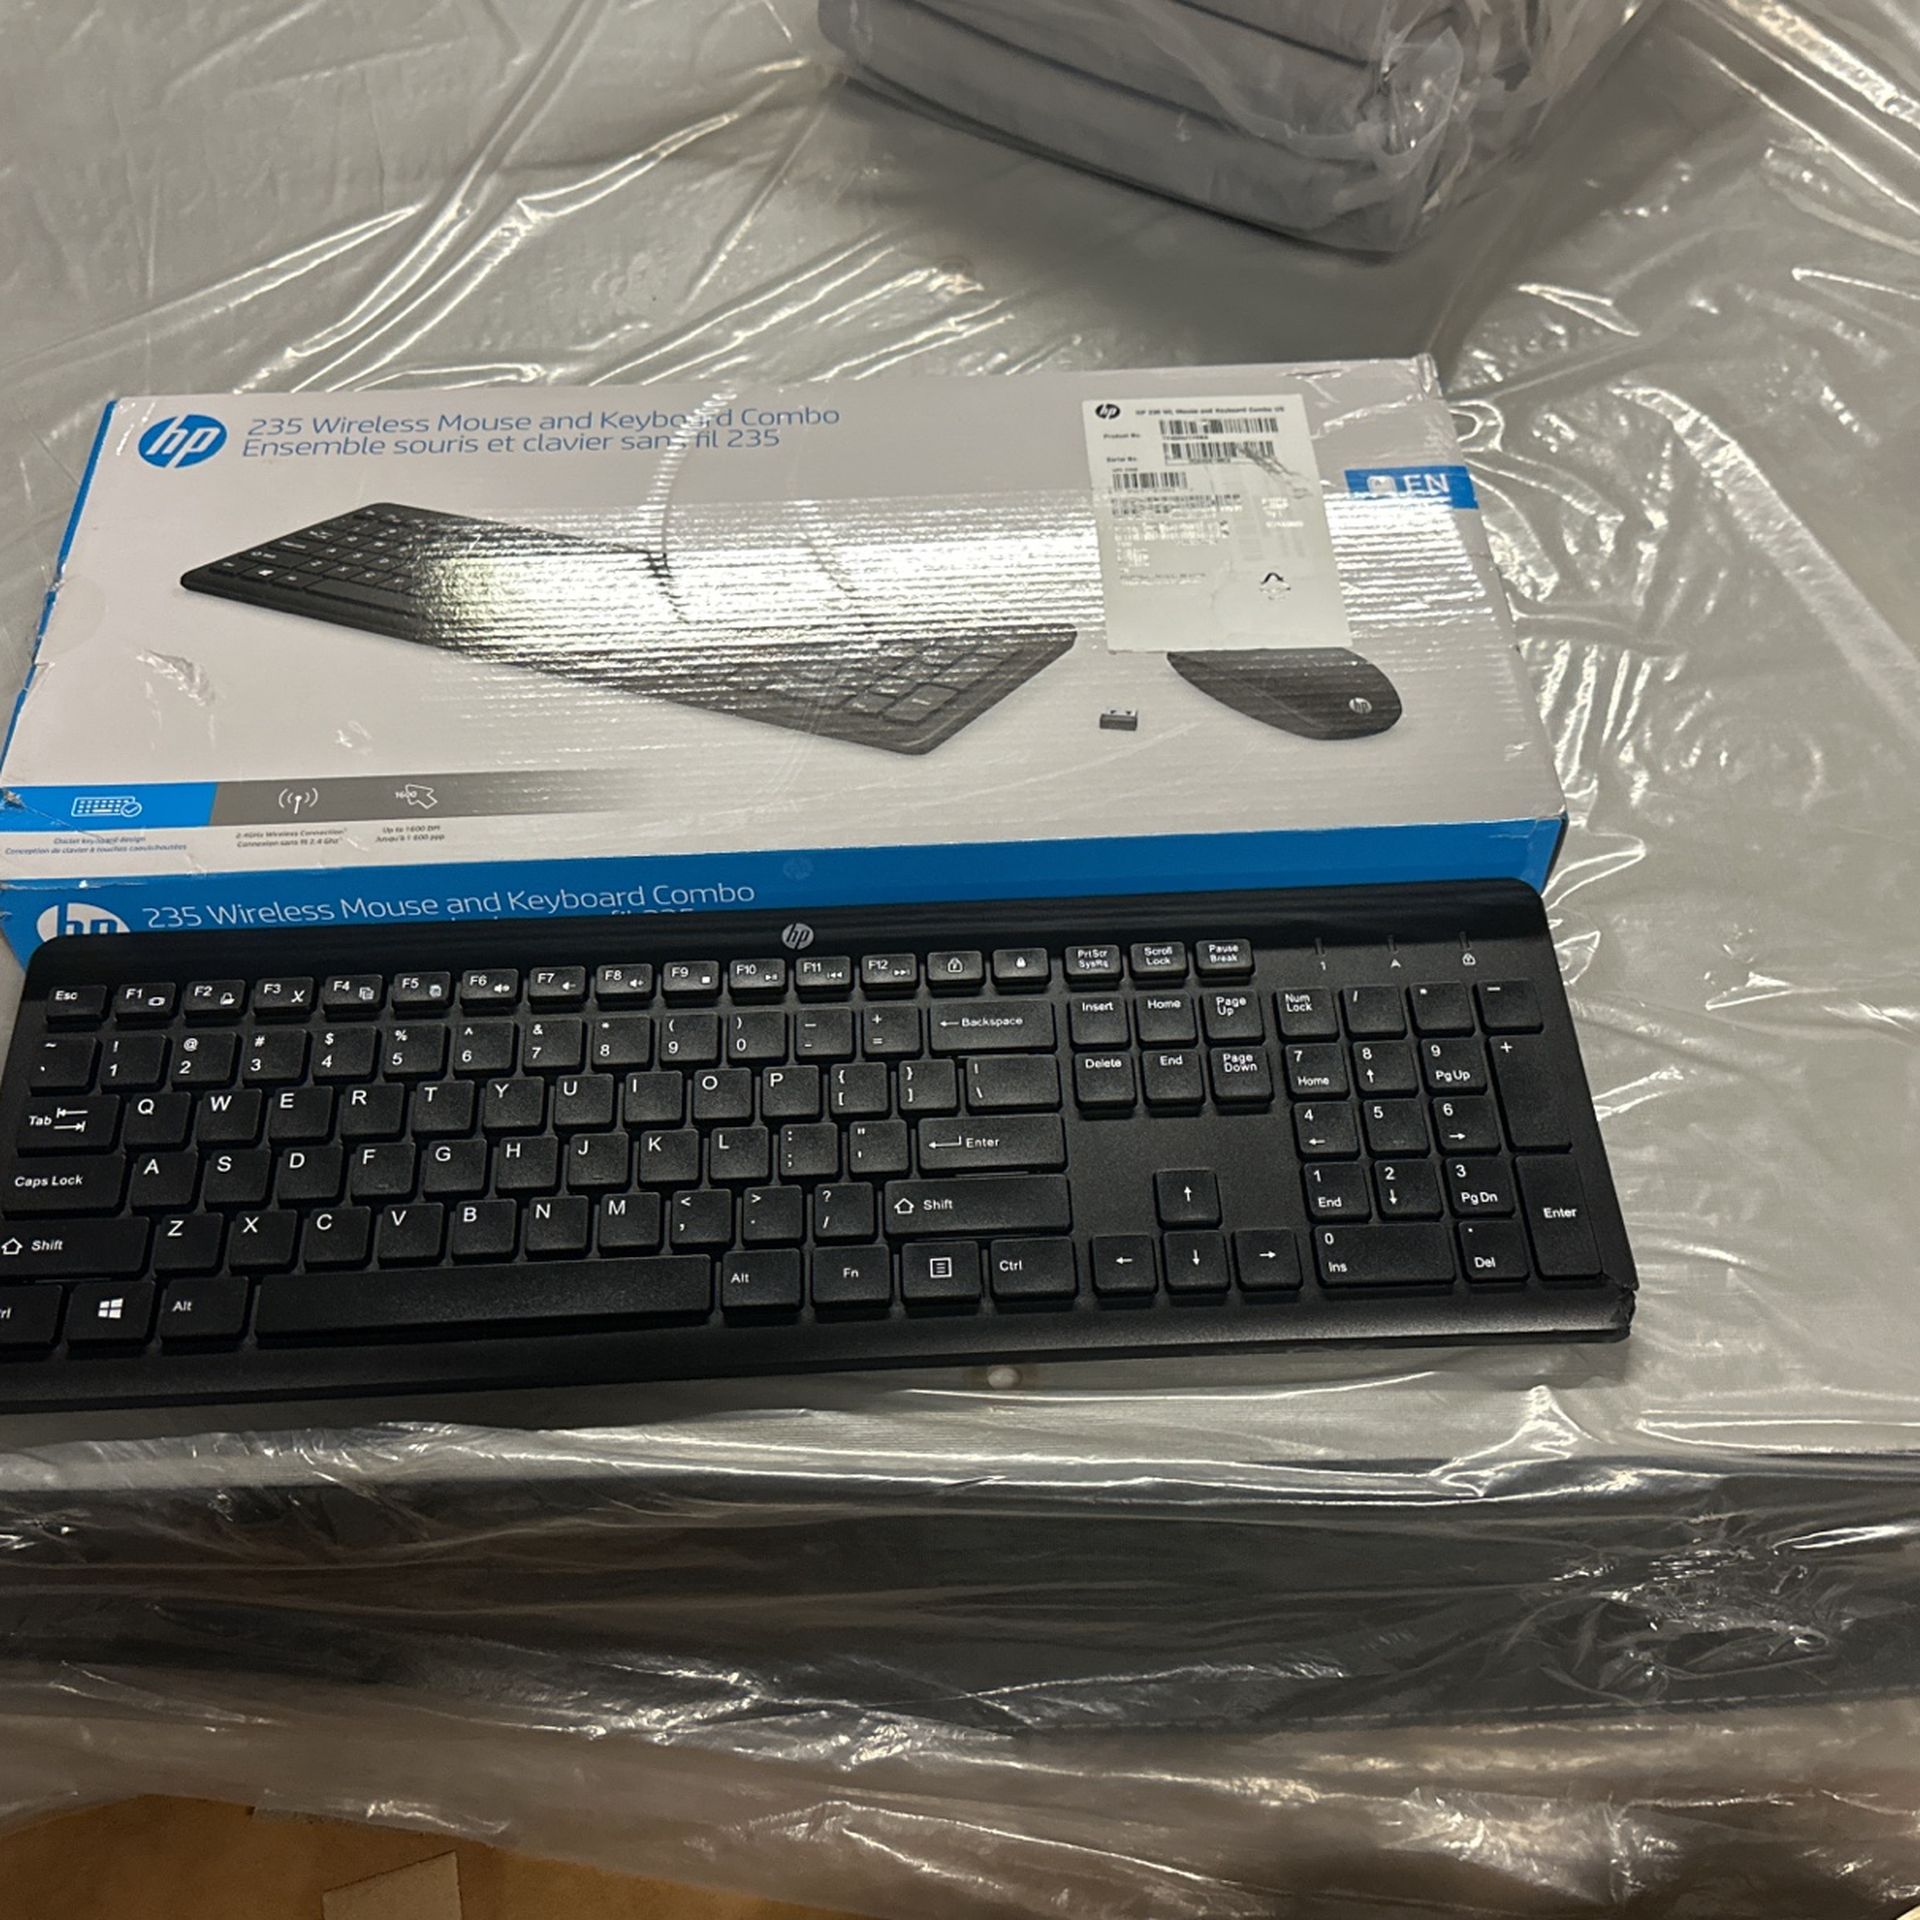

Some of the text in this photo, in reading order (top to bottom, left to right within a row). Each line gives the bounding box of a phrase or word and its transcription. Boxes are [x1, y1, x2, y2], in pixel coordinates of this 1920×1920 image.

[1095, 403, 1121, 419] hp
[248, 406, 840, 436] 235 Wireless Mouse and Keybod Combo
[138, 414, 228, 468] hp
[242, 429, 780, 457] Ensemble souris et clavier san fil 235
[1402, 473, 1450, 495] EN
[1348, 697, 1372, 714] hp
[142, 883, 756, 928] 235 Wireless Mouse and Keyboard Combo
[780, 921, 816, 951] hp
[1144, 946, 1173, 957] Scroll
[1208, 944, 1239, 953] Pause
[868, 959, 889, 970] F12
[1145, 956, 1171, 966] Lock
[1209, 954, 1238, 963] Break
[671, 966, 689, 978] F9
[735, 962, 758, 977] F10
[802, 960, 823, 975] F11
[469, 974, 488, 987] F6
[537, 972, 555, 984] F7
[604, 969, 622, 981] F8
[263, 983, 282, 994] F3
[333, 980, 350, 992] F4
[401, 977, 420, 989] F5
[55, 990, 78, 1001] Esc
[125, 988, 143, 1000] F1
[194, 985, 213, 997] F2
[1284, 993, 1311, 1003] Num
[1082, 1001, 1114, 1012] Insert
[1147, 999, 1182, 1009] Home
[1215, 996, 1247, 1009] Page
[1285, 1000, 1313, 1013] Lock
[1217, 1004, 1237, 1017] Up
[961, 1017, 1023, 1028] Backspace
[599, 1043, 610, 1057] 8
[668, 1040, 679, 1054] 9
[736, 1038, 747, 1052] 0
[1430, 1044, 1441, 1057] 9
[392, 1052, 403, 1066] 5
[461, 1049, 472, 1063] 6
[531, 1046, 542, 1059] 7
[1222, 1053, 1253, 1065] Page
[1293, 1049, 1303, 1062] 7
[1362, 1047, 1373, 1060] 8
[179, 1060, 192, 1074] 2
[250, 1058, 262, 1072] 3
[321, 1054, 332, 1068] 4
[1084, 1058, 1122, 1069] Delete
[1159, 1054, 1184, 1066] End
[1223, 1060, 1258, 1073] Down
[109, 1063, 118, 1077] 1
[632, 1078, 637, 1093] I
[701, 1075, 718, 1091] O
[770, 1072, 784, 1088] P
[1297, 1076, 1330, 1087] Home
[424, 1086, 438, 1102] T
[494, 1083, 509, 1099] Y
[563, 1080, 578, 1096] U
[210, 1095, 232, 1112] W
[279, 1092, 295, 1109] E
[351, 1089, 367, 1105] R
[137, 1098, 155, 1115] Q
[1373, 1105, 1384, 1119] 5
[1442, 1102, 1454, 1117] 6
[29, 1115, 53, 1126] Tab
[1304, 1108, 1314, 1121] 4
[577, 1140, 589, 1156] J
[648, 1136, 662, 1152] K
[718, 1134, 730, 1150] L
[965, 1137, 1000, 1149] Enter
[362, 1148, 376, 1165] F
[435, 1146, 451, 1162] G
[506, 1142, 521, 1158] H
[143, 1158, 160, 1175] A
[216, 1155, 232, 1172] S
[289, 1152, 305, 1169] D
[1313, 1169, 1322, 1182] 1
[1384, 1166, 1395, 1181] 2
[1455, 1164, 1467, 1178] 3
[14, 1174, 83, 1189] Caps Lock
[608, 1199, 626, 1215] M
[923, 1198, 953, 1211] Shift
[1317, 1196, 1343, 1208] End
[391, 1210, 407, 1226] V
[463, 1206, 477, 1223] B
[535, 1203, 551, 1219] N
[1543, 1207, 1577, 1219] Enter
[167, 1220, 184, 1237] Z
[242, 1216, 259, 1233] X
[316, 1213, 333, 1231] C
[31, 1239, 63, 1252] Shift
[1324, 1232, 1335, 1245] 0
[999, 1259, 1023, 1272] Ctrl
[1328, 1261, 1348, 1273] Ins
[1474, 1256, 1496, 1268] Del
[730, 1272, 749, 1284] Alt
[843, 1267, 859, 1278] Fn
[172, 1300, 192, 1312] Alt
